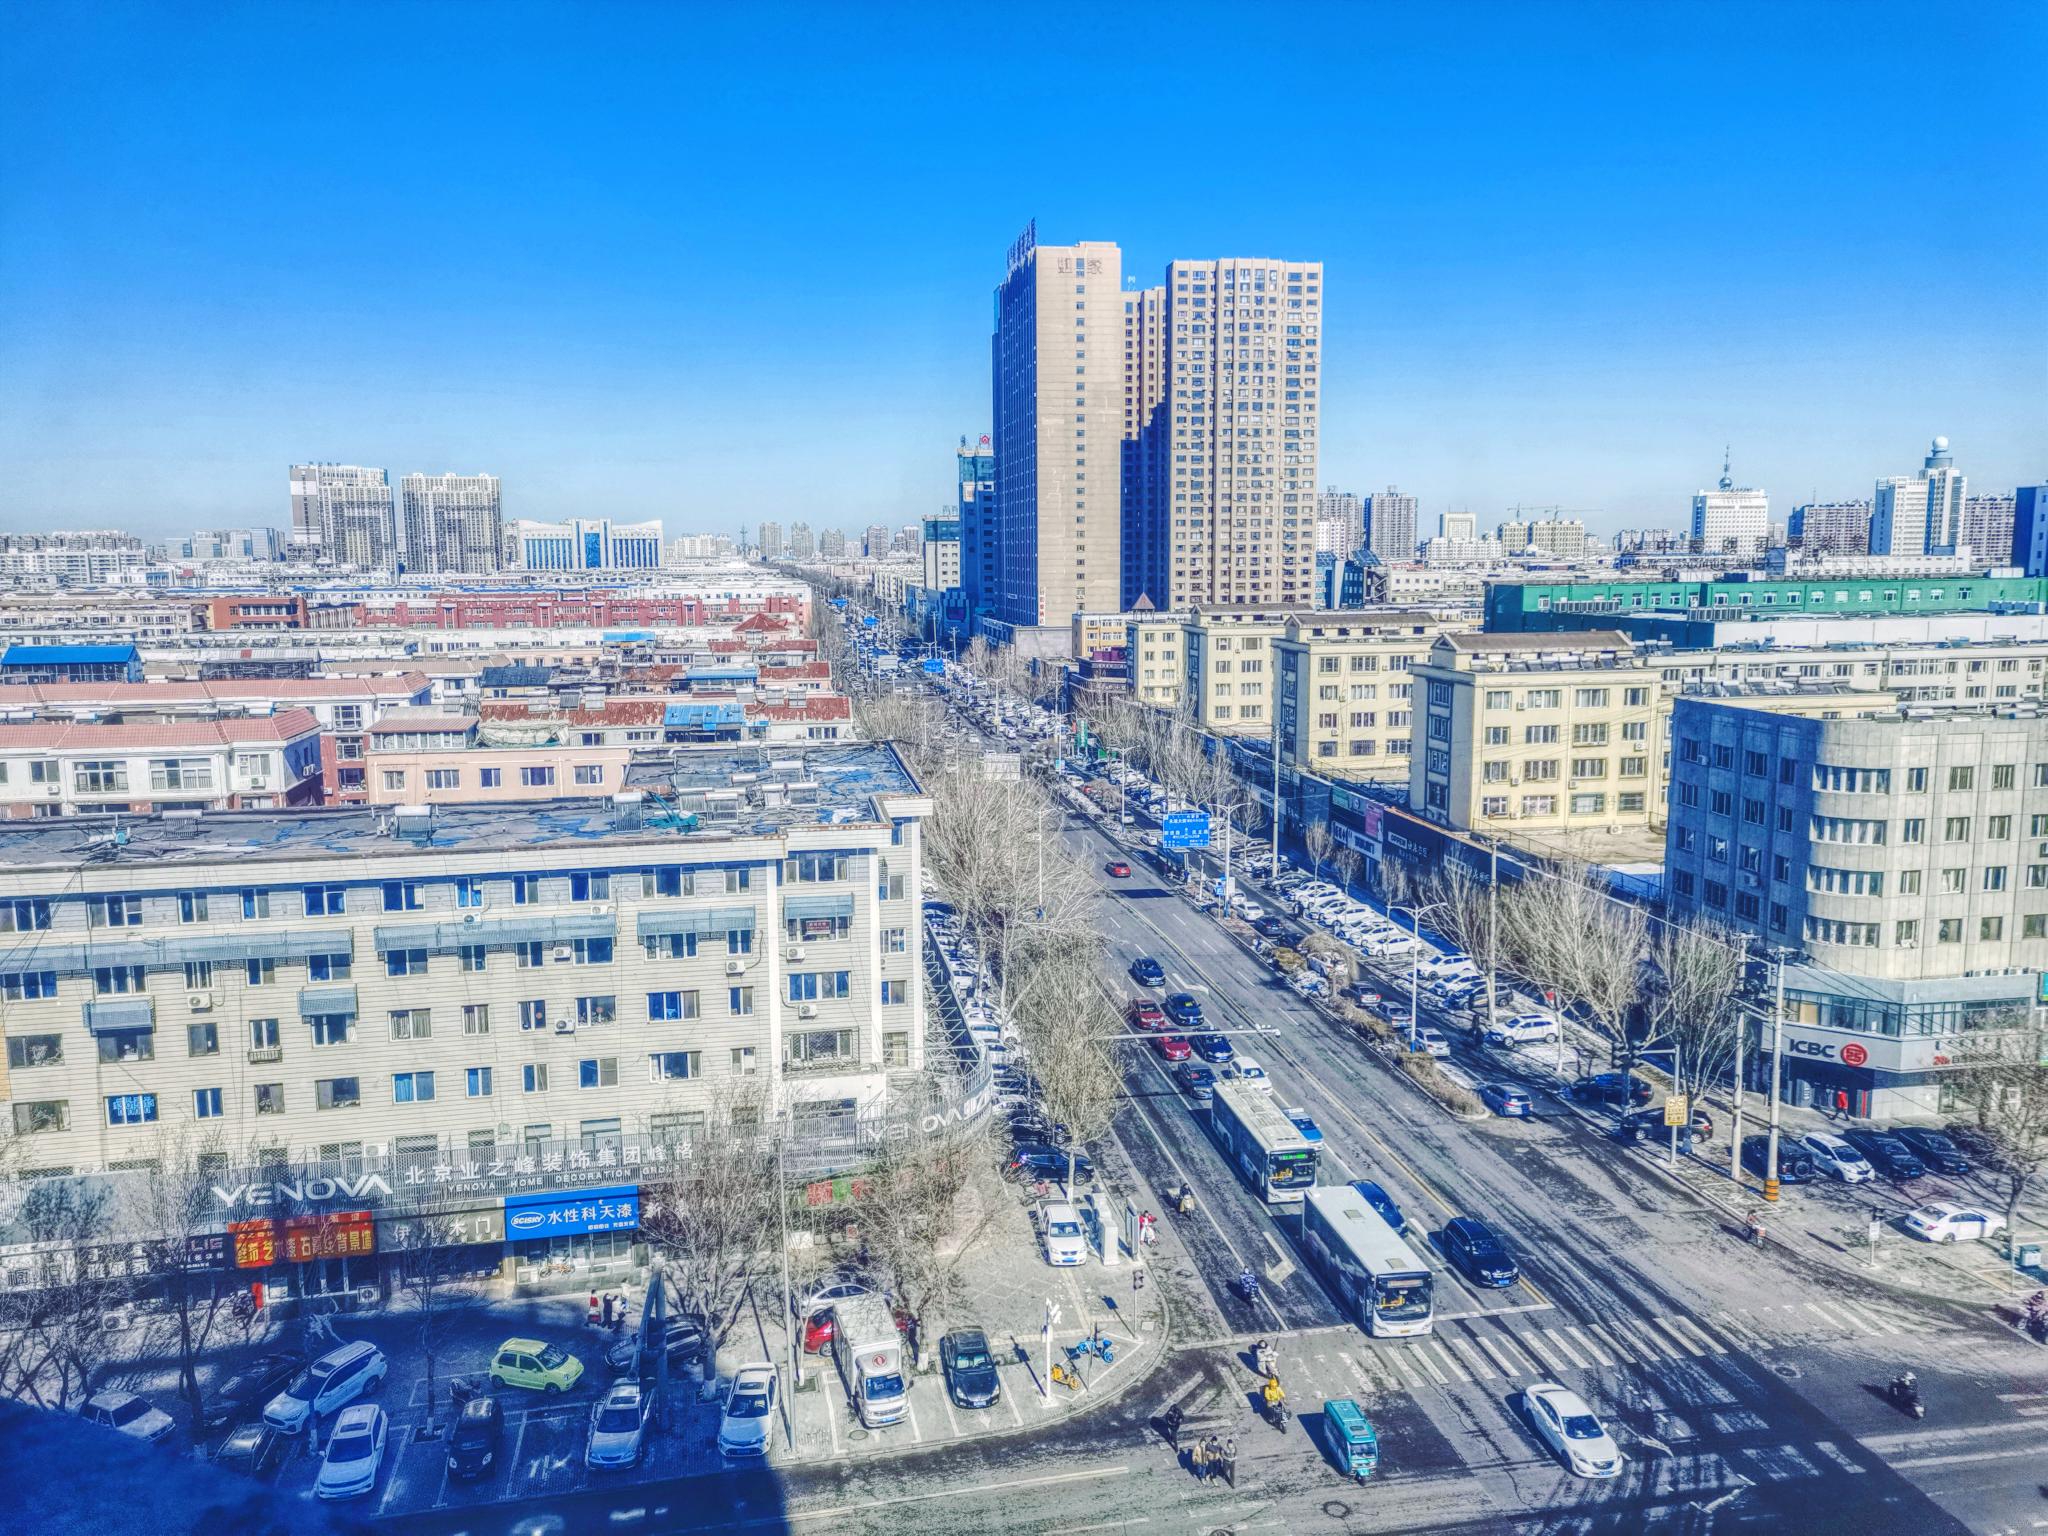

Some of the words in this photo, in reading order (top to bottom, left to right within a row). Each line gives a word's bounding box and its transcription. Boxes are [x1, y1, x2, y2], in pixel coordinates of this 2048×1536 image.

[1790, 1038, 1836, 1058] ICBC
[211, 1174, 393, 1208] YENOVA
[448, 1182, 495, 1193] YENOVA
[510, 1176, 543, 1188] HOME
[556, 1168, 631, 1183] DECORATION
[513, 1215, 543, 1225] SCISKY
[547, 1203, 632, 1225] 水性科天漆
